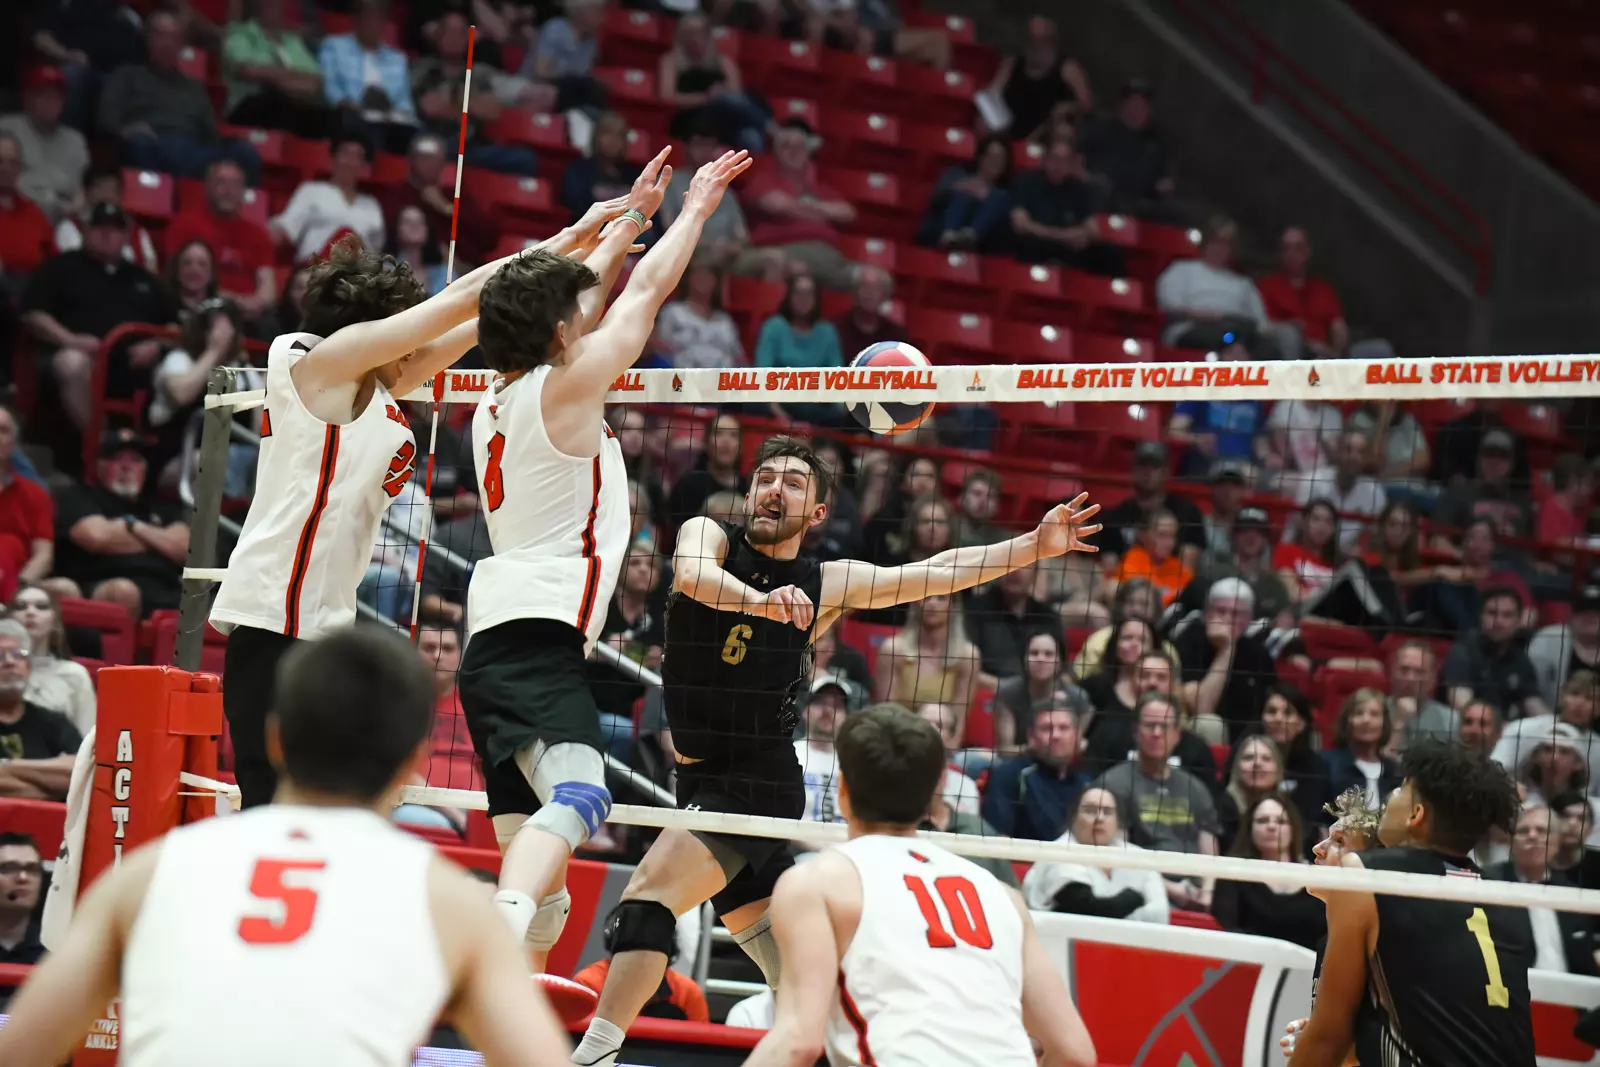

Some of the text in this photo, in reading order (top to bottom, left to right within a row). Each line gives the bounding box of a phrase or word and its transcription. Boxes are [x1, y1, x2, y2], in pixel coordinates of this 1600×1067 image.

[451, 374, 488, 391] BALL
[608, 373, 645, 391] ALL
[718, 371, 937, 390] BALL STATE VOLLEYBALL
[1017, 366, 1269, 389] BALL STATE VOLLEYBALL
[1366, 359, 1600, 384] BALL STATE VOLLEY
[721, 623, 753, 665] 6
[238, 857, 327, 944] 5
[903, 874, 993, 949] 10
[1466, 907, 1509, 1009] 1
